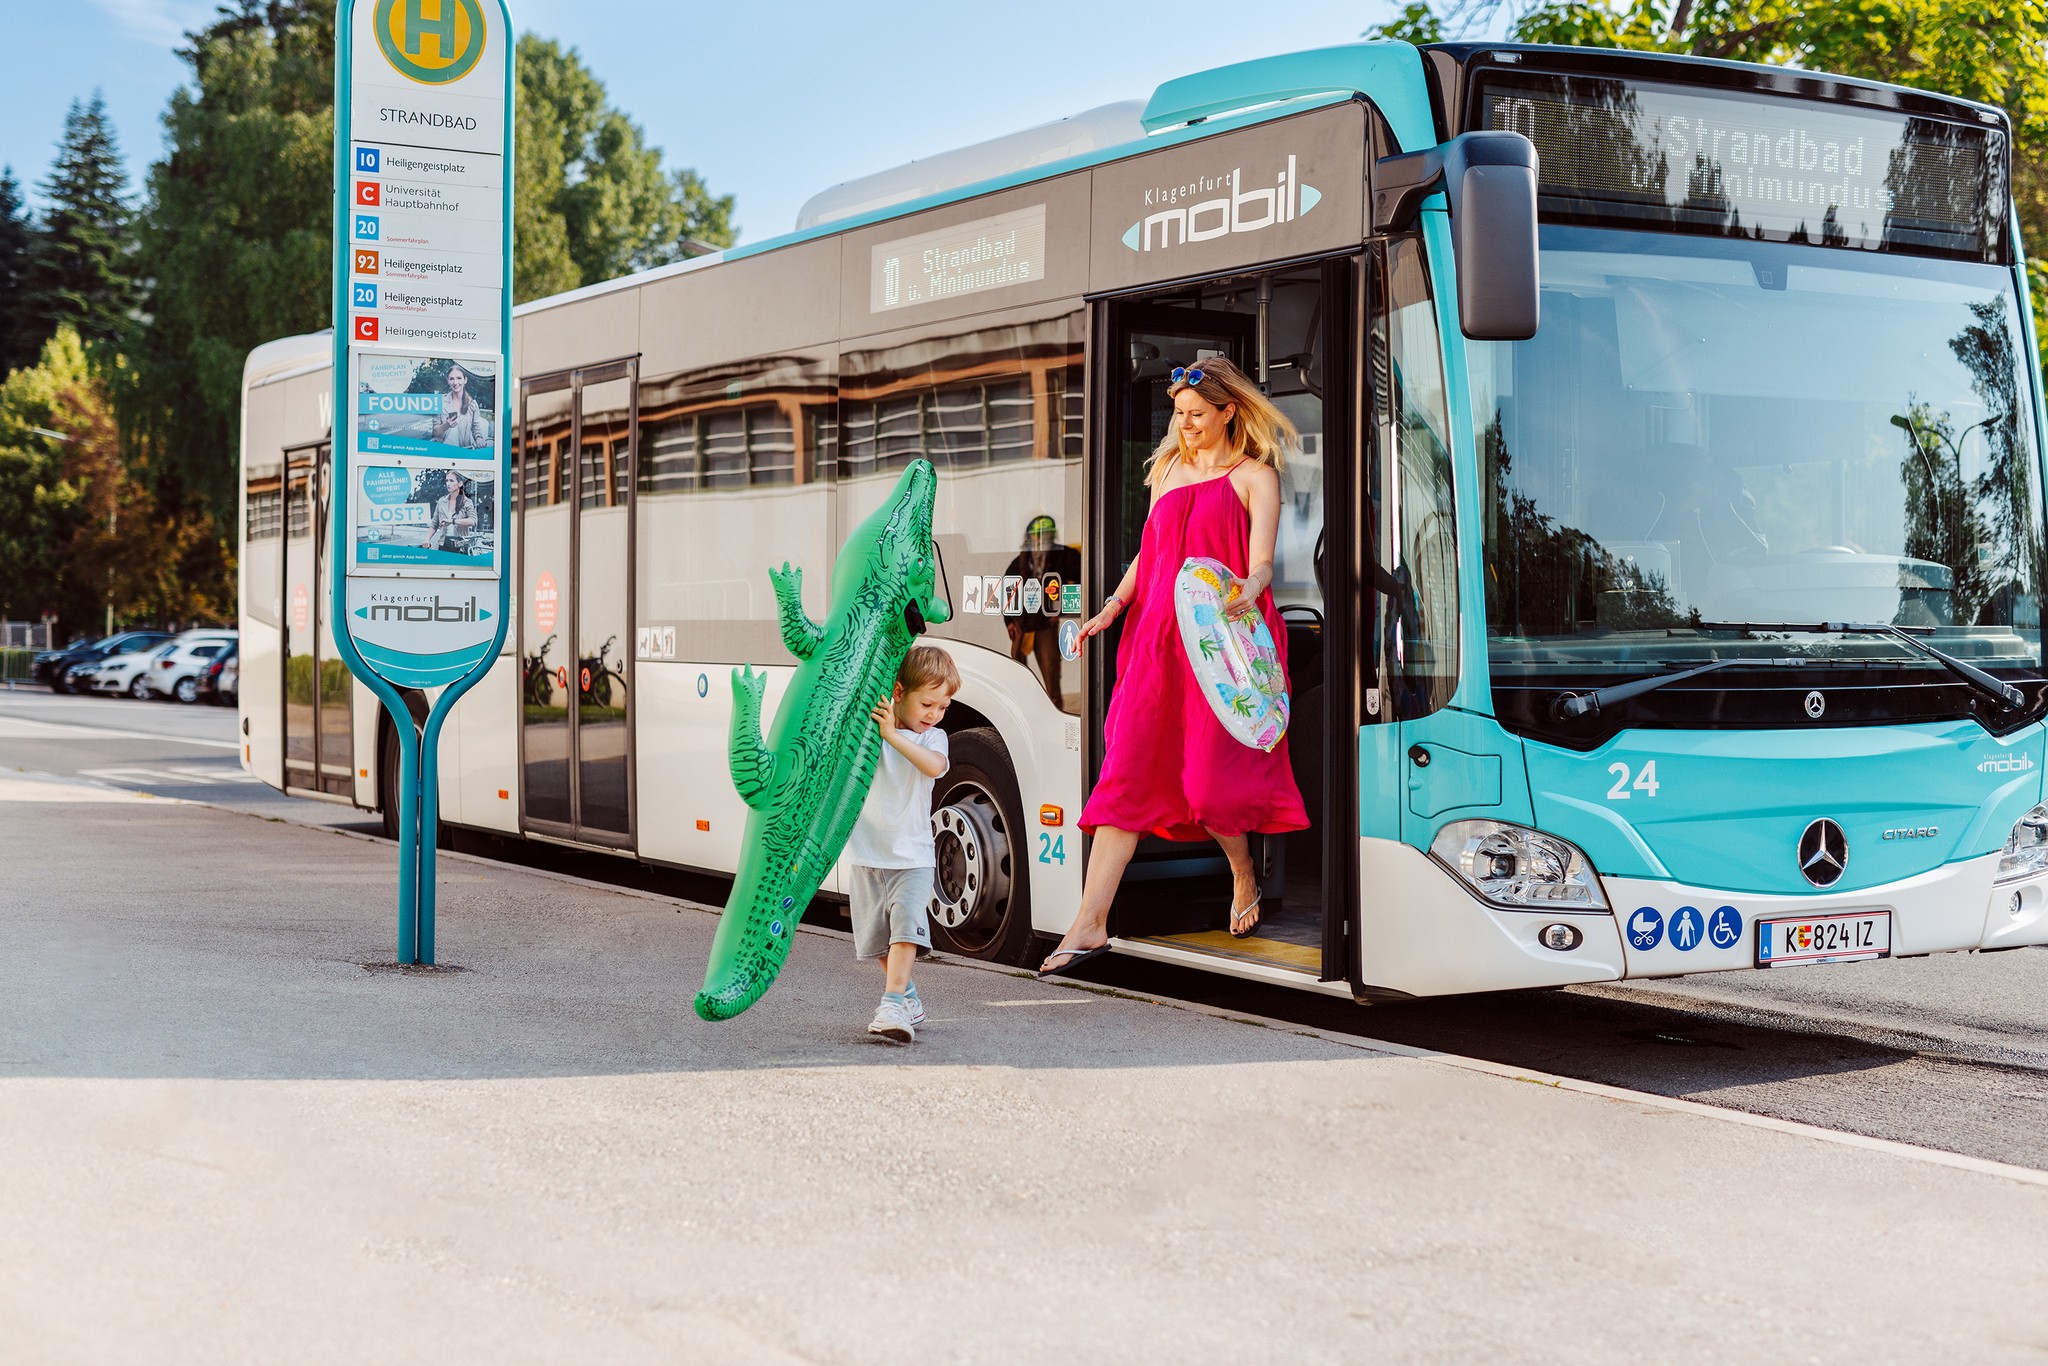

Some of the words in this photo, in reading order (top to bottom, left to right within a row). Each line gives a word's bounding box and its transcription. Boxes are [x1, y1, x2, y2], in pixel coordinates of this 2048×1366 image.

[379, 107, 477, 131] STRANDBAD
[1667, 115, 1864, 176] Strandbad
[360, 152, 375, 167] 10
[386, 156, 466, 174] Heiligengeistplatz
[385, 184, 441, 198] Universität
[1144, 172, 1231, 206] Klagenfurt
[1684, 159, 1896, 212] Minimundus
[361, 186, 375, 201] C
[385, 198, 459, 212] Hauptbahnhof
[1143, 154, 1297, 252] mobil
[357, 220, 377, 235] 20
[386, 236, 429, 244] Sommerfahrplan
[922, 230, 1016, 274] Strandbad
[357, 254, 376, 270] 92
[384, 258, 463, 275] Heiligengeistplatz
[386, 271, 428, 279] Sommerfahrplan
[930, 258, 1030, 298] Minimundus
[356, 288, 375, 303] 20
[384, 291, 463, 308] Heiligengeistplatz
[385, 304, 427, 312] Sommerfahrplan
[360, 321, 374, 336] C
[385, 326, 477, 341] Heiligengeistplatz
[370, 363, 407, 371] FAHRPLAN
[371, 370, 407, 378] GESUCHT?
[368, 396, 439, 412] FOUND!
[366, 477, 408, 487] FAHRPLÄNE!
[377, 471, 396, 479] ALLE
[376, 485, 400, 493] IMMER!
[369, 507, 424, 522] LOST?
[370, 593, 434, 604] Klagenfurt
[370, 595, 477, 622] mobil
[1983, 752, 2028, 773] mobil
[1606, 760, 1660, 800] 24
[1881, 826, 1940, 841] CITARO
[1039, 832, 1066, 866] 24
[1762, 946, 1769, 955] A
